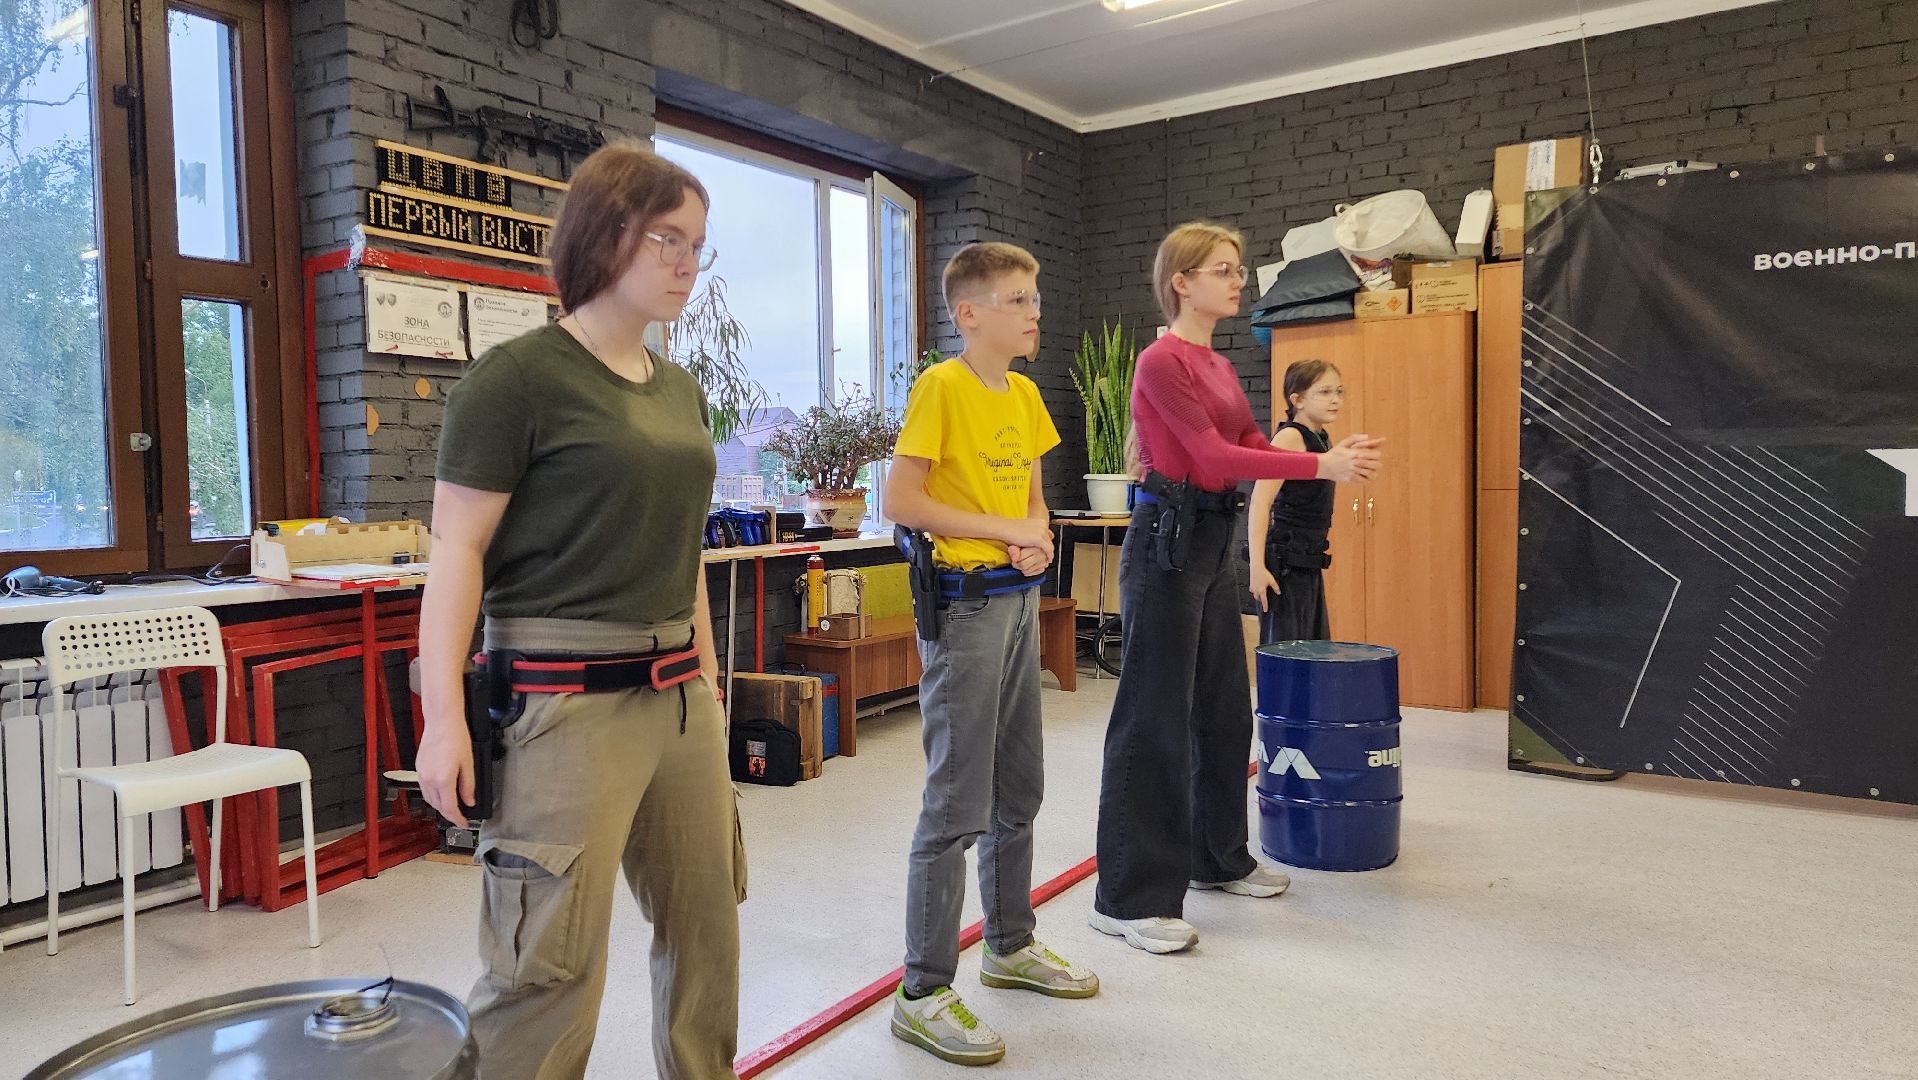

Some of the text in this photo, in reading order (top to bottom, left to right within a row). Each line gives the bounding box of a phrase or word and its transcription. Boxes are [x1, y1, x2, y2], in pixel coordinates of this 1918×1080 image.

[370, 192, 472, 242] ПЕРВЫЙ
[1754, 241, 1917, 271] военно-п
[404, 316, 430, 328] ЗОНА
[378, 330, 450, 346] БЕЗОПАСНОСТИ
